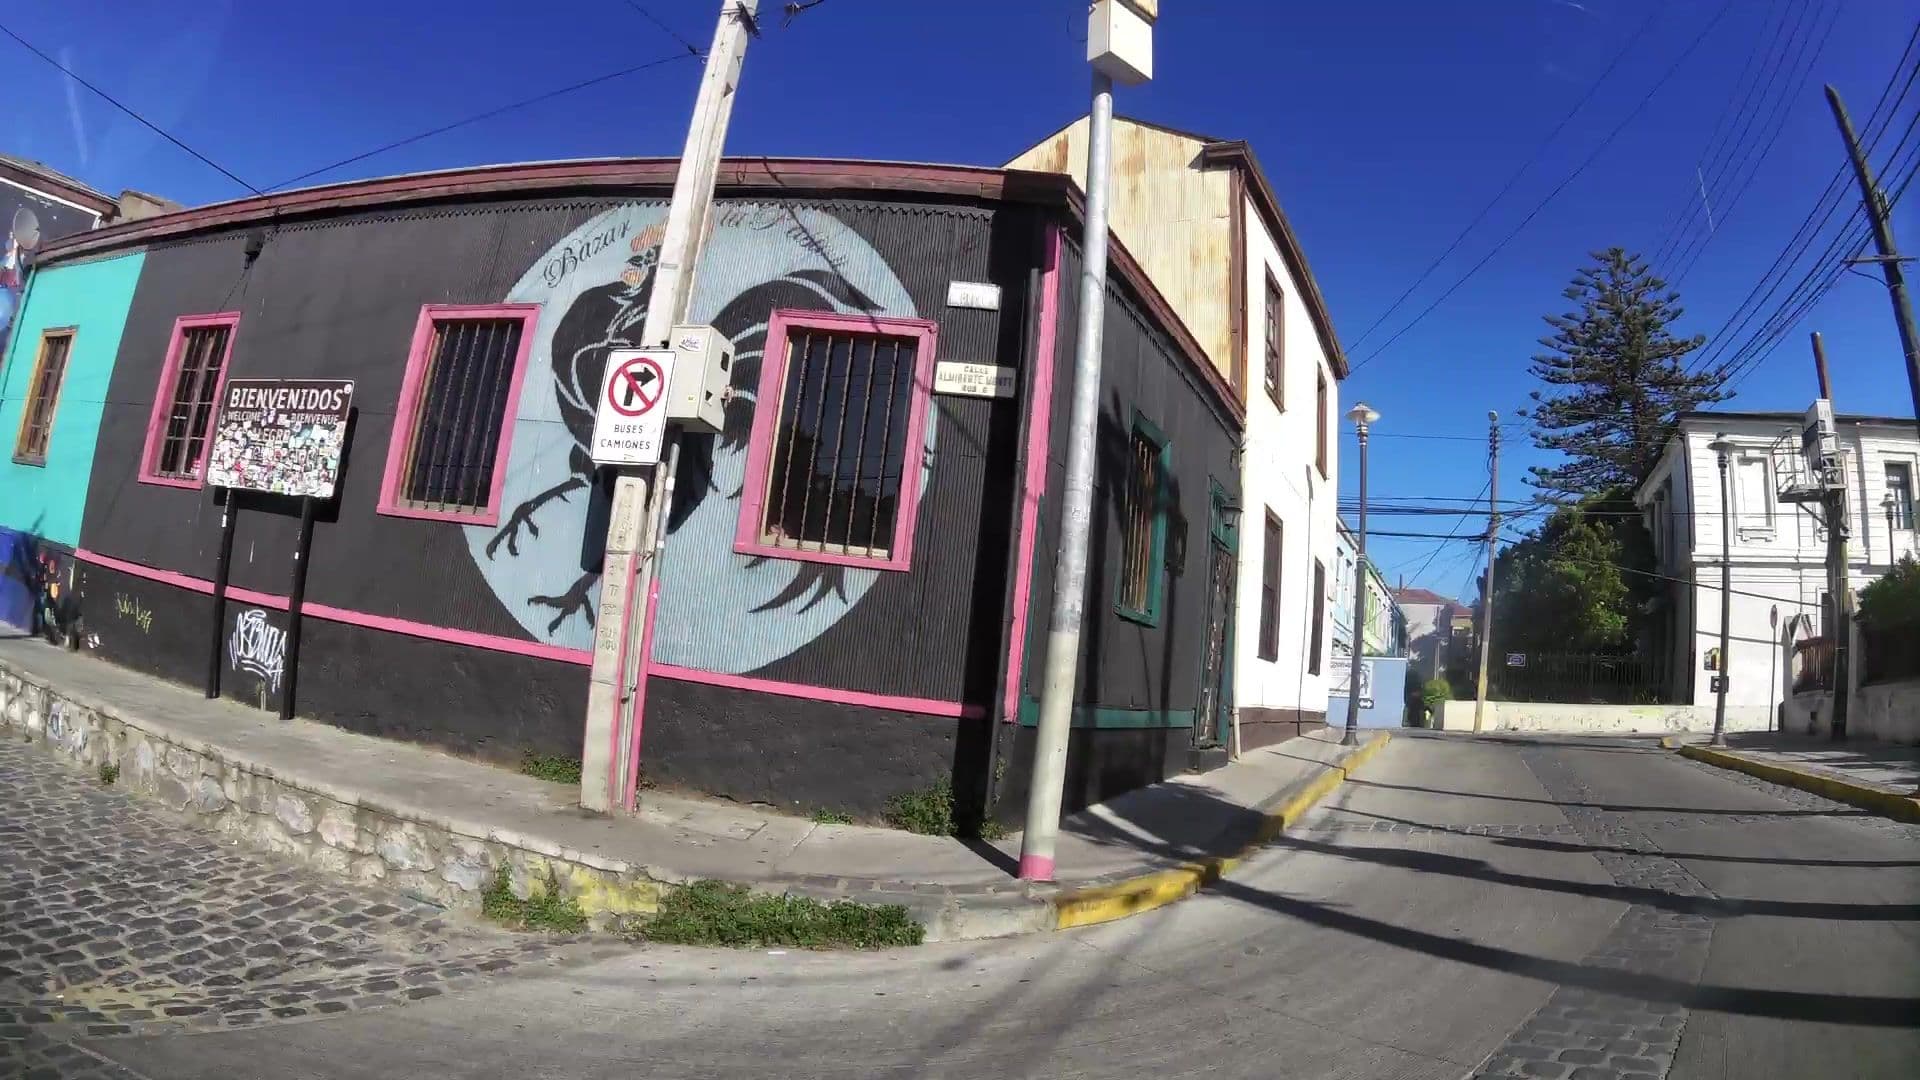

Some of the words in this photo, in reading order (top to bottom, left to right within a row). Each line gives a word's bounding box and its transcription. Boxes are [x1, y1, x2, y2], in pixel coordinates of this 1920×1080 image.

[544, 219, 632, 289] Bazar
[229, 387, 344, 411] BIENVENIDOS
[227, 411, 261, 422] WELCOME
[291, 413, 340, 425] BIENVENUE
[614, 424, 644, 434] BUSES
[600, 439, 651, 450] CAMIONES
